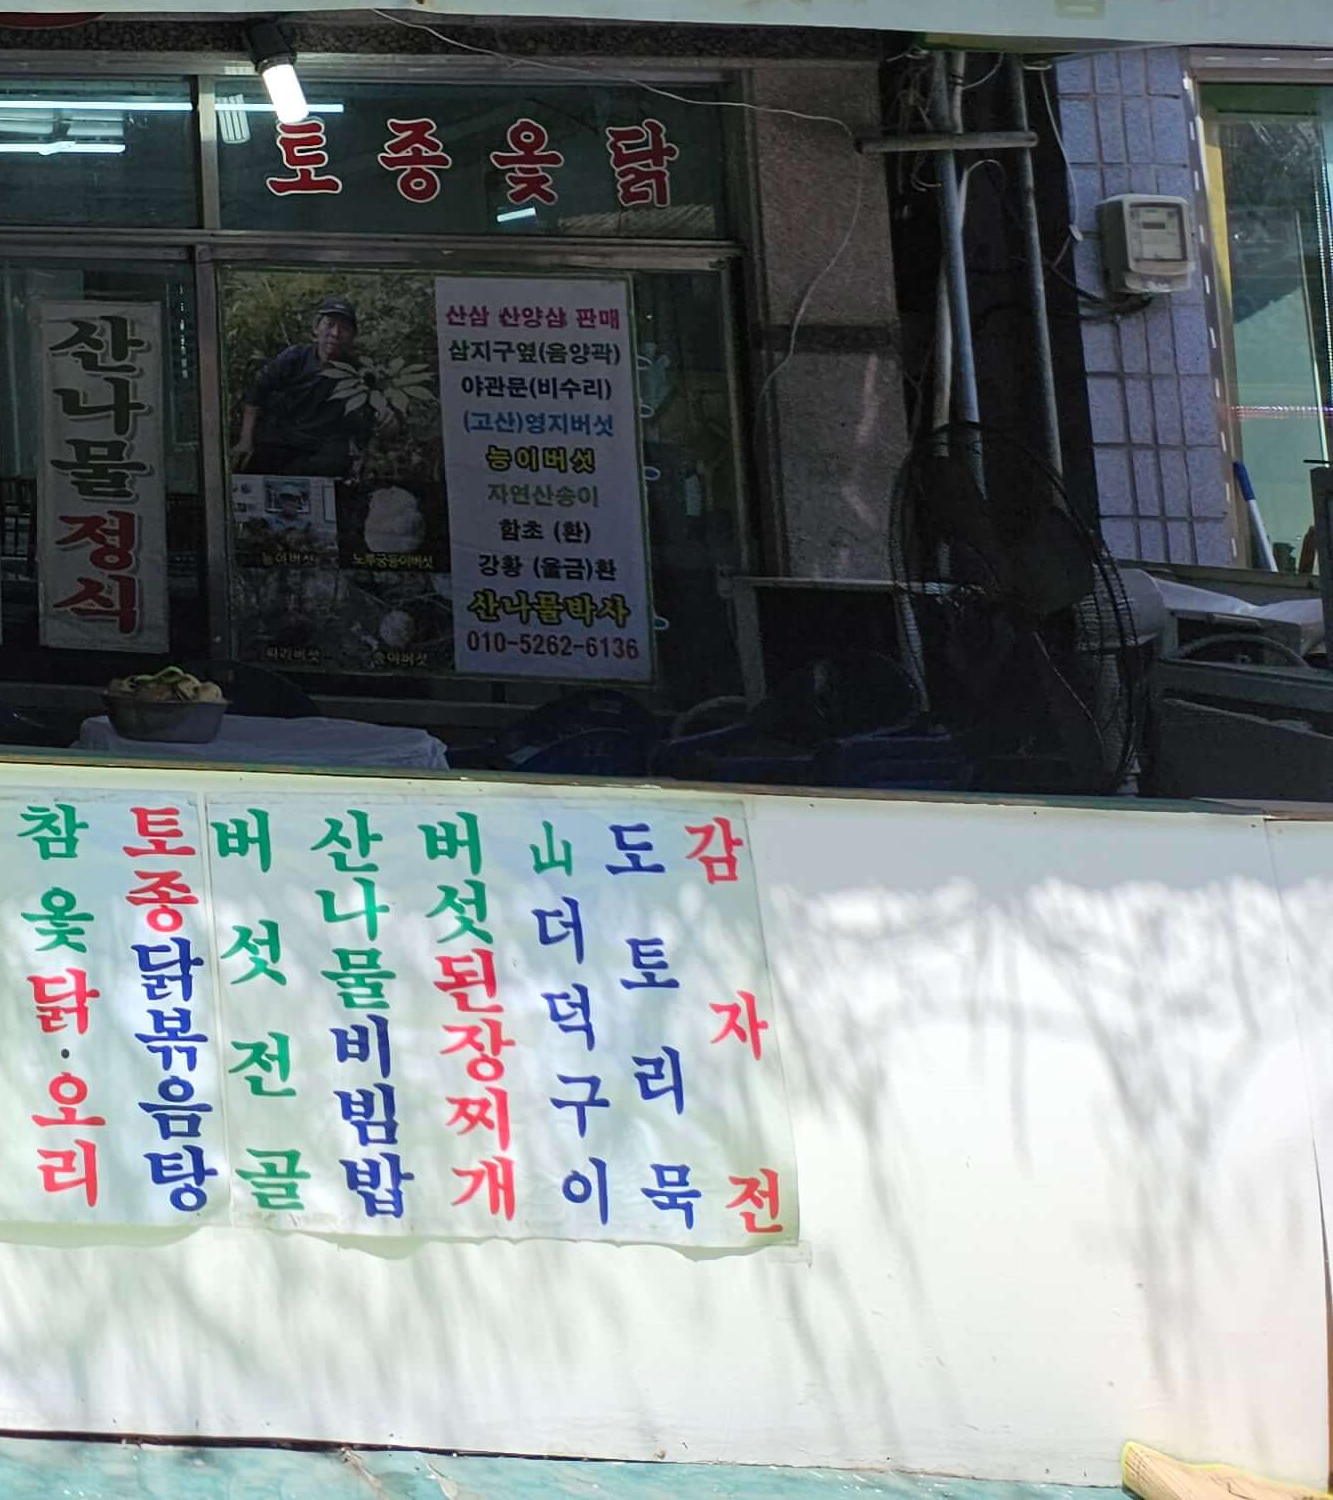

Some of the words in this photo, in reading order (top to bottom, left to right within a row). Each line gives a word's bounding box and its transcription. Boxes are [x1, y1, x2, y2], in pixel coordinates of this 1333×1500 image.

[445, 304, 489, 328] 산삼
[499, 305, 567, 330] 산양삼
[575, 308, 620, 331] 판매
[48, 315, 146, 634] 산나물정식
[486, 445, 596, 474] 능이버섯
[487, 483, 599, 509] 자연산송이
[499, 518, 543, 541] 함초
[478, 553, 523, 578] 강황
[469, 589, 630, 628] 산나물박사
[467, 634, 639, 660] 010-5262-6136
[210, 808, 310, 1210] 버섯전골
[310, 809, 415, 1218] 산나물비빔밥
[417, 811, 516, 1221] 버섯된장찌개
[605, 822, 702, 1230] 도토리묵
[684, 817, 783, 1234] 감자전
